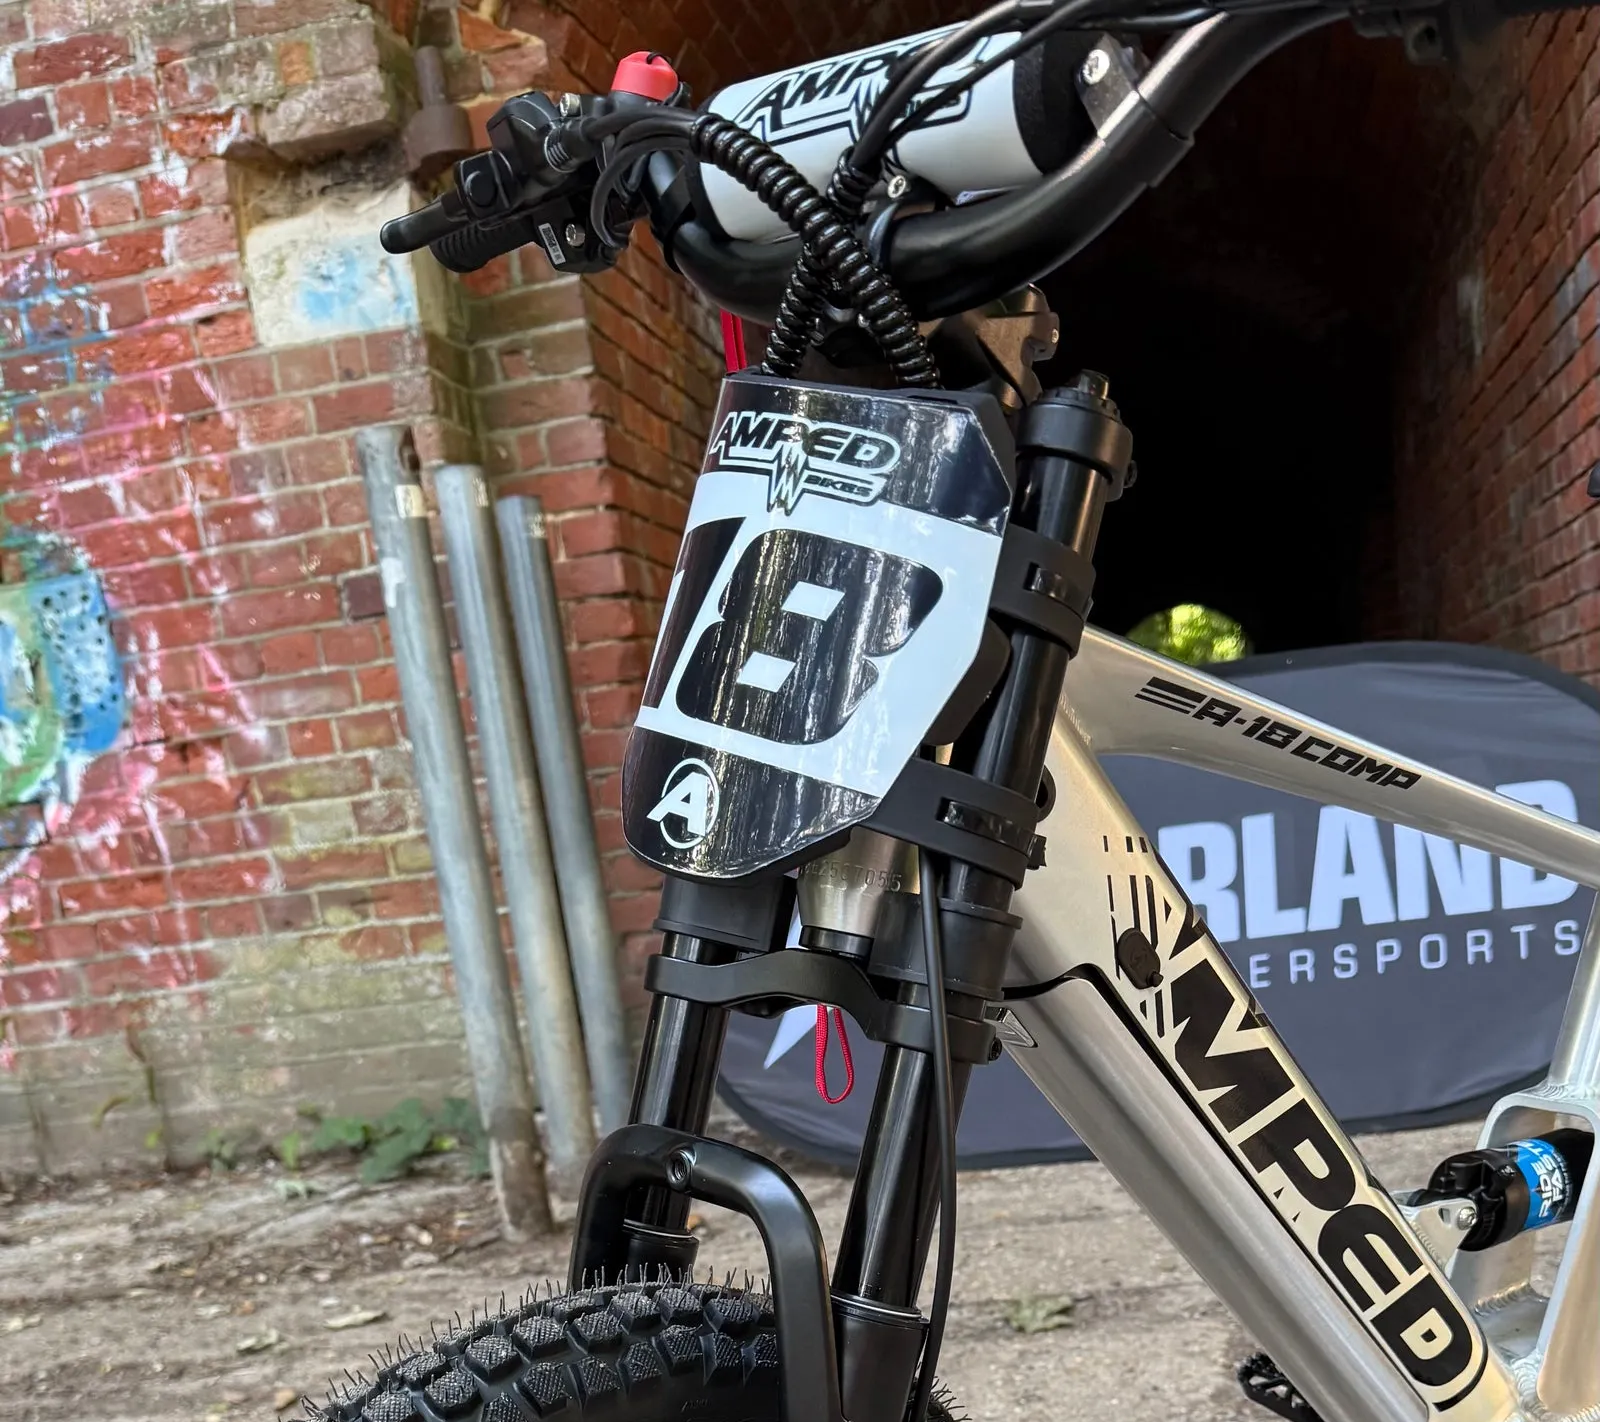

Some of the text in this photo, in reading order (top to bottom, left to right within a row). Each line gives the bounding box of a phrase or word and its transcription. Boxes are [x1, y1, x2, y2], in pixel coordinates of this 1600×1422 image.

[711, 413, 899, 472] AMPED
[803, 474, 873, 498] BIKES
[642, 516, 943, 746] 18
[1290, 736, 1421, 790] COMP
[1530, 1160, 1553, 1218] RIDE
